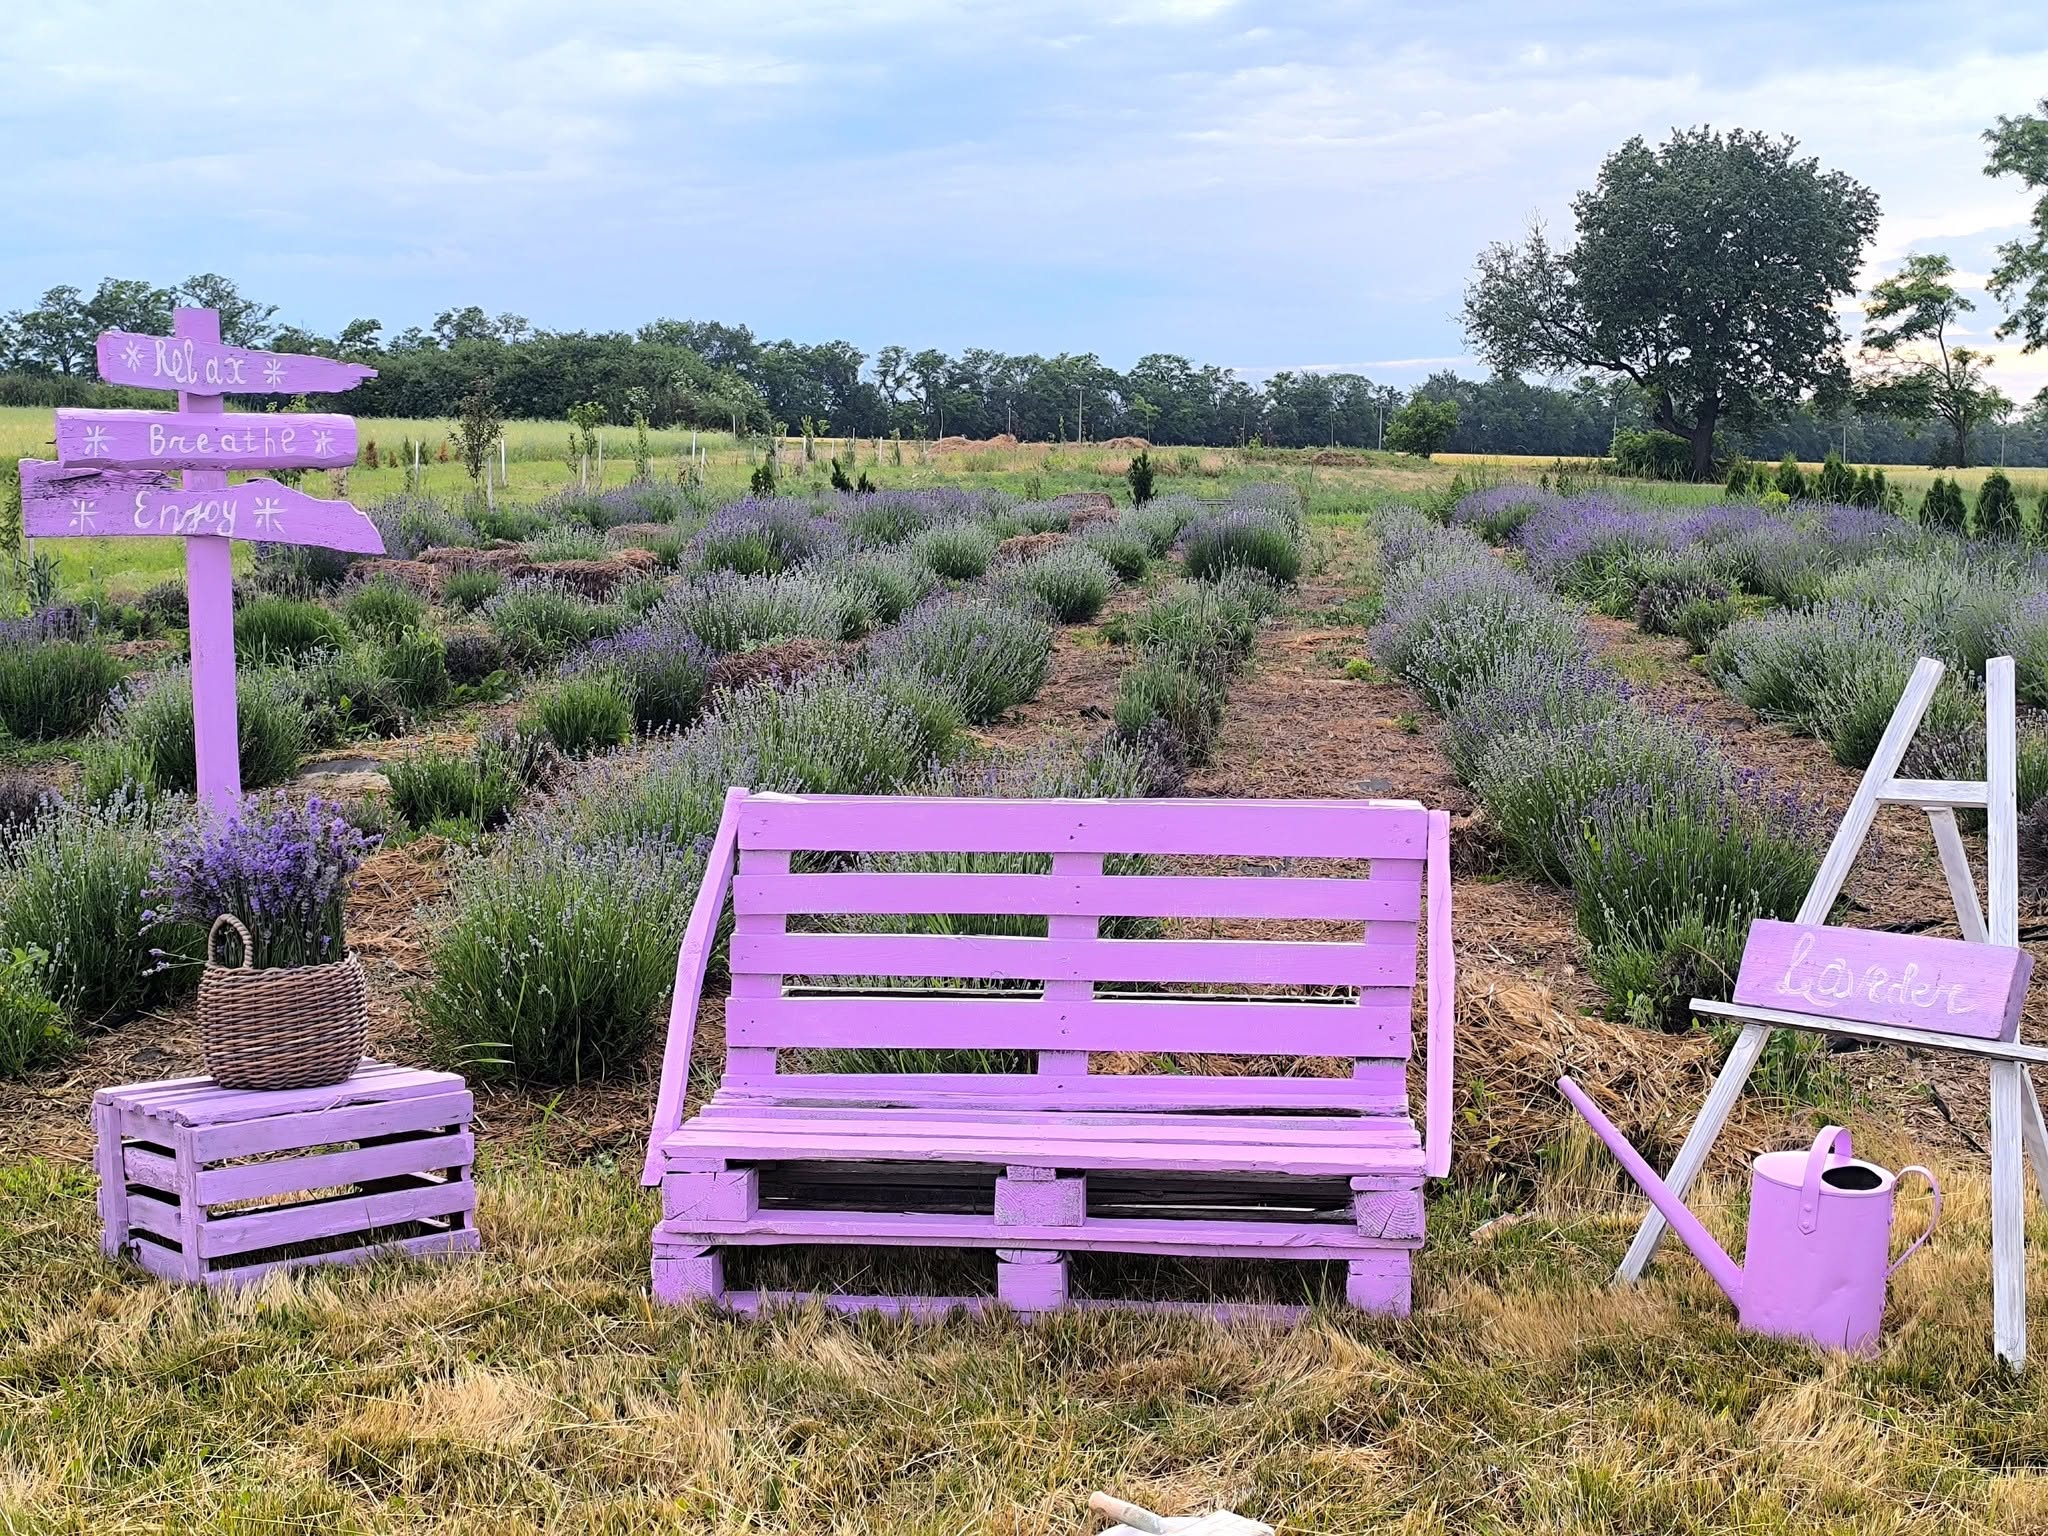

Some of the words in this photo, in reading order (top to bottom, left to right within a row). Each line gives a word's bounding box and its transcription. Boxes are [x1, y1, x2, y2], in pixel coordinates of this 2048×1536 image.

[153, 339, 248, 384] Relax
[150, 424, 297, 456] Breathe
[133, 490, 237, 535] Enjoy
